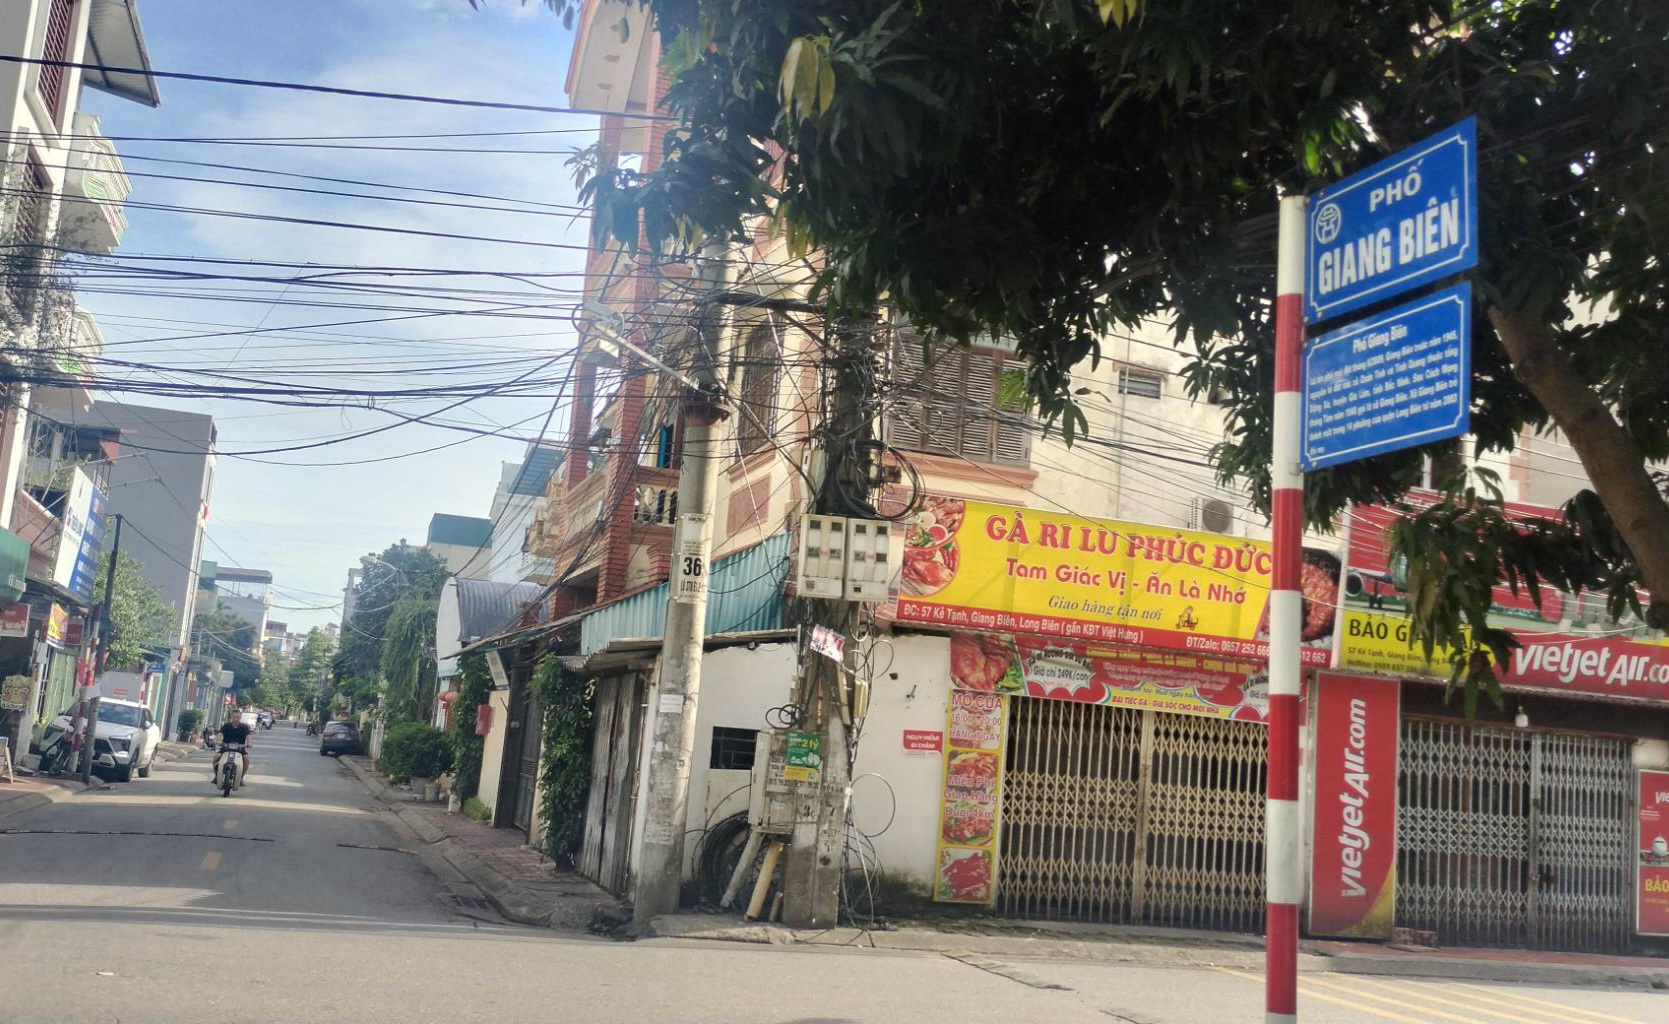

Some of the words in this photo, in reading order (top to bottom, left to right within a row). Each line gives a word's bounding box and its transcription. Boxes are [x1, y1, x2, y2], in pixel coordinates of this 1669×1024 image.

[1370, 159, 1424, 213] PHỐ
[1318, 227, 1391, 295] GIANG
[1399, 197, 1459, 265] BIÊN
[1368, 332, 1389, 348] Giang
[1390, 324, 1407, 341] Biên
[986, 511, 1030, 544] GÀ
[1038, 521, 1072, 549] RI
[1127, 532, 1205, 565] PHÚC
[1212, 542, 1272, 575] ĐỨC
[683, 556, 702, 577] 36
[1006, 558, 1047, 580] Tam
[1055, 564, 1101, 586] Giác
[1108, 570, 1126, 596] Vị
[1146, 570, 1172, 596] Ăn
[1179, 579, 1201, 599] Là
[1208, 583, 1247, 605] Nhớ
[903, 603, 920, 616] ĐC:
[921, 605, 932, 618] 57
[933, 607, 945, 619] Kẻ
[947, 608, 970, 623] Tạnh,
[971, 611, 995, 627] Giang
[996, 614, 1018, 628] Biên,
[1019, 616, 1040, 631] Long
[1041, 619, 1060, 632] Biên
[1083, 623, 1101, 636] KĐT
[1101, 625, 1117, 640] Việt
[1118, 628, 1139, 643] Hưng
[1048, 595, 1078, 610] Giao
[1081, 599, 1114, 616] hàng
[1117, 604, 1138, 620] tận
[1141, 606, 1163, 621] nơi
[1349, 613, 1389, 640] BẢO
[1186, 636, 1220, 650] ĐT/Zalo:
[1301, 651, 1310, 662] 12
